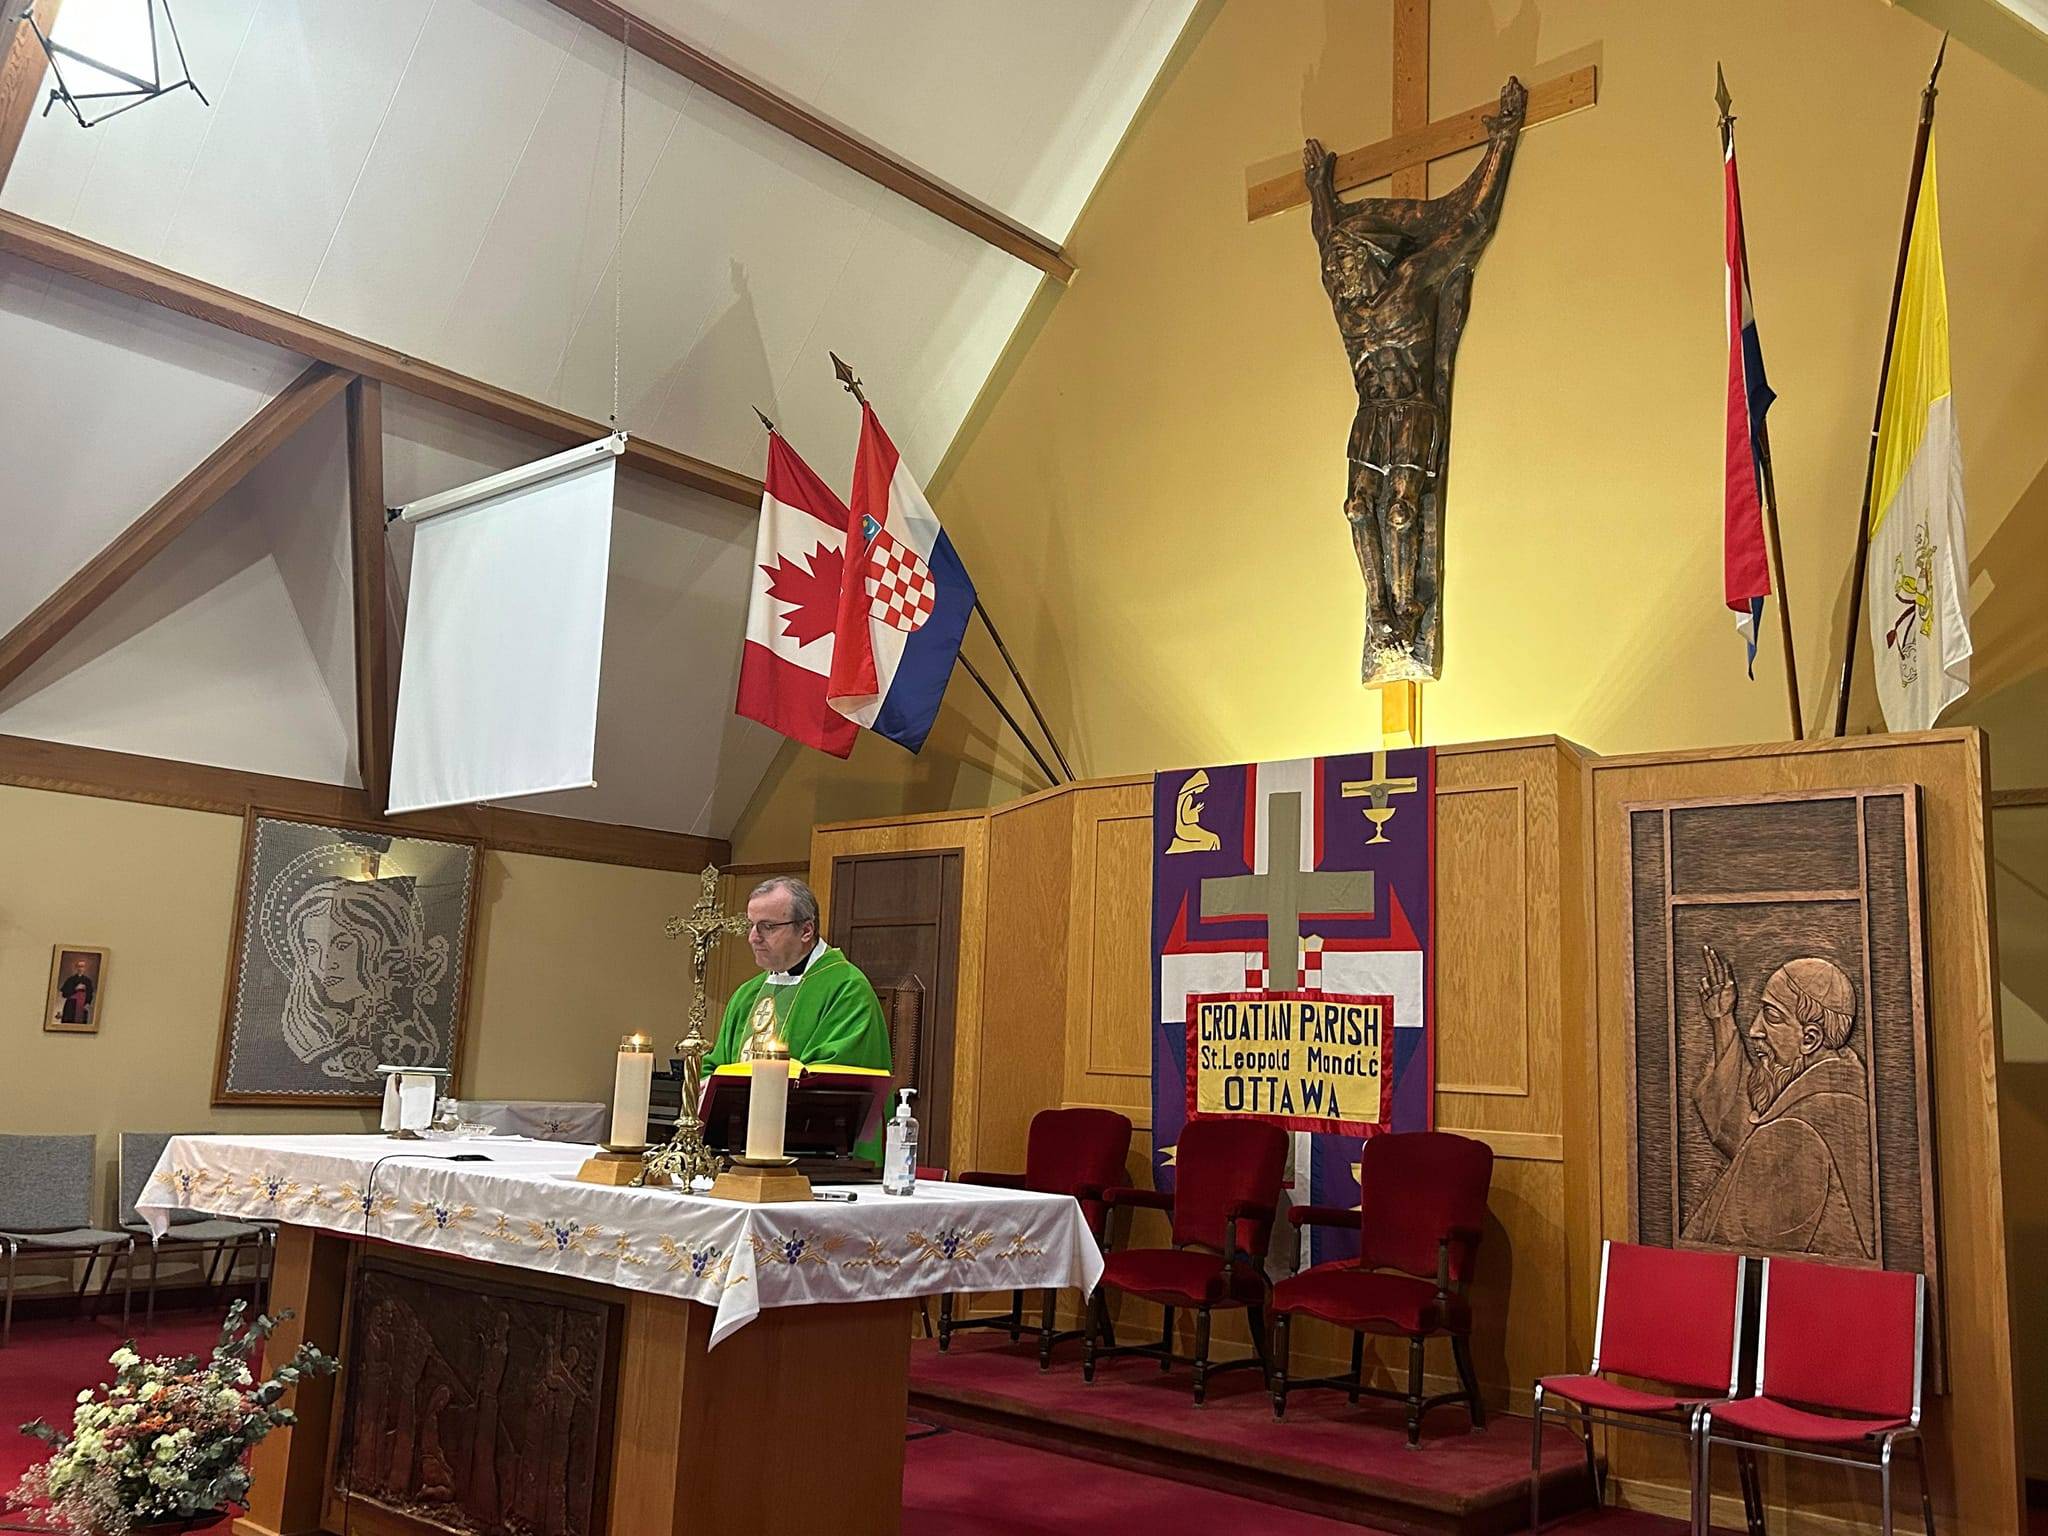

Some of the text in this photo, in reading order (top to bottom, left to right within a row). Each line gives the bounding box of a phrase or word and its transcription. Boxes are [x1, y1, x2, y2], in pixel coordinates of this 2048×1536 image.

[1201, 1003, 1379, 1047] CROATIAN PARISH
[1224, 1076, 1341, 1118] OTTAWA
